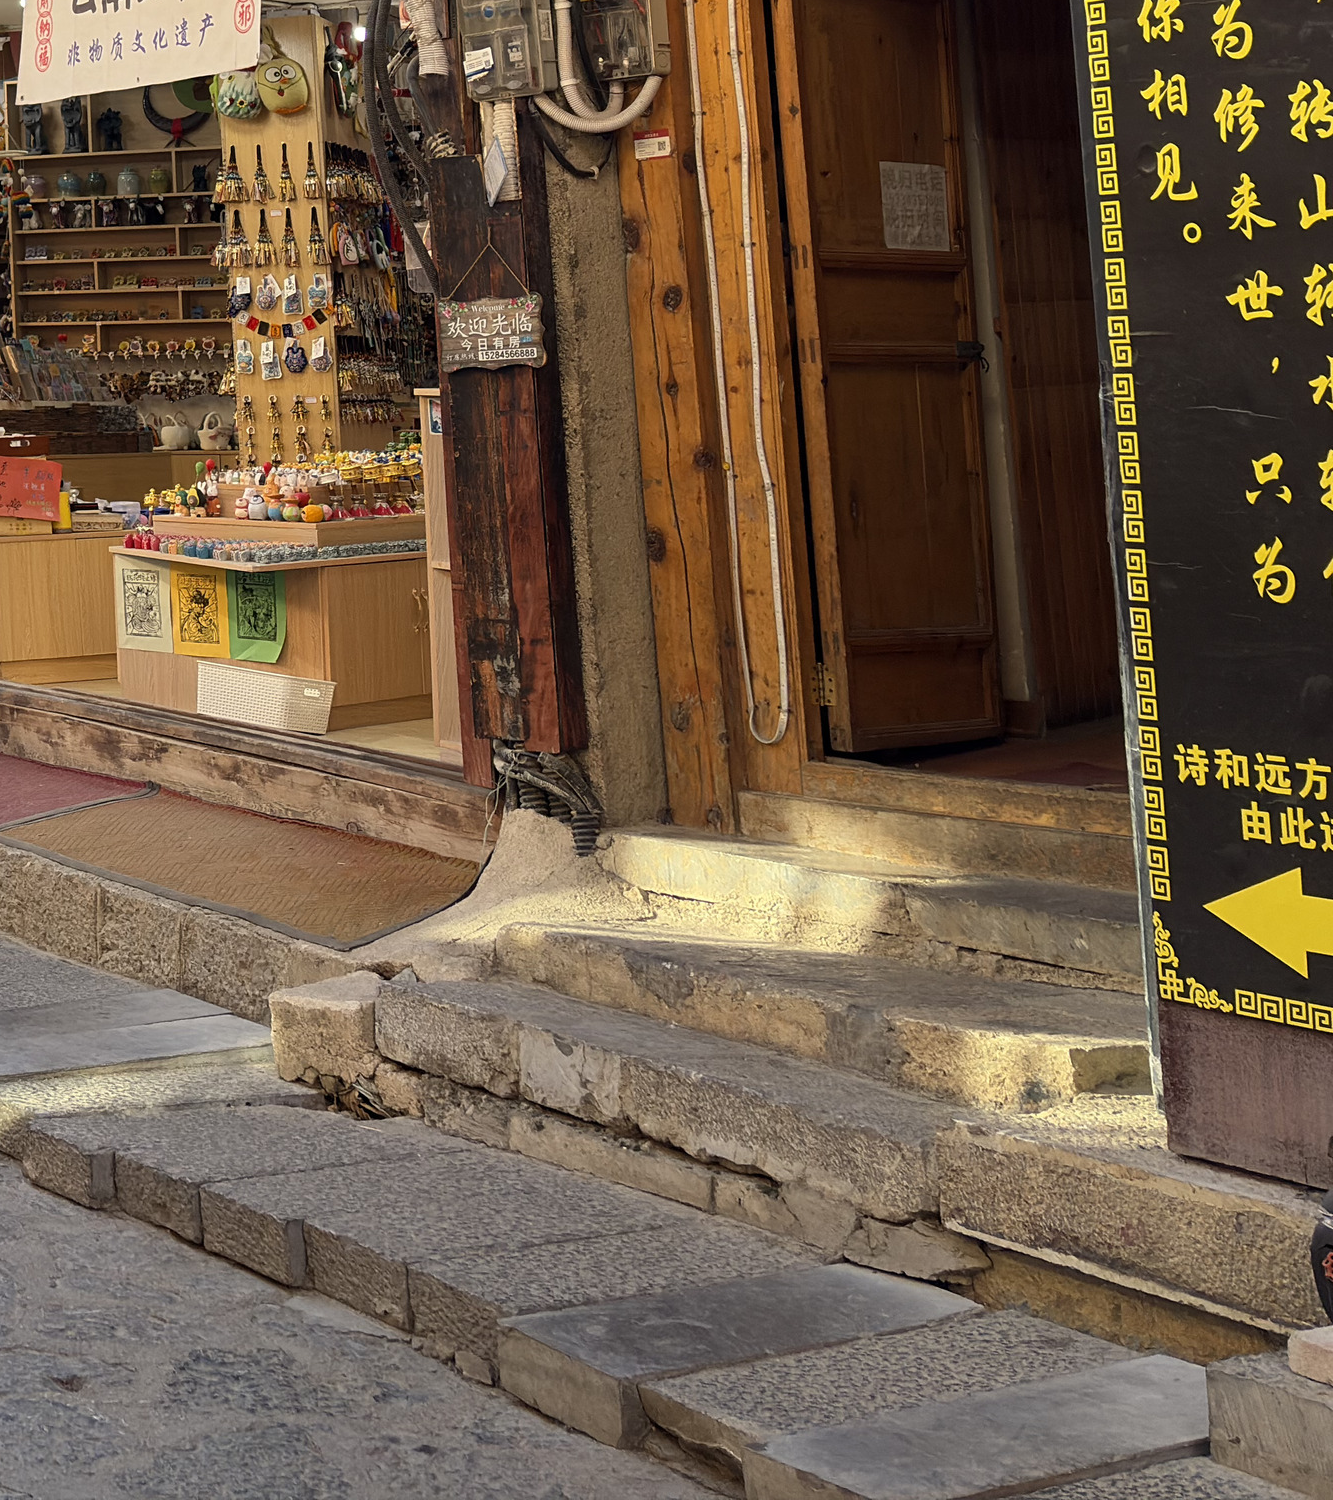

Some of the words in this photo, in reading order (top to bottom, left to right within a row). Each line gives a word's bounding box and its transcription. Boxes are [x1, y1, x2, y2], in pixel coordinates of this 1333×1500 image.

[471, 304, 505, 313] Welcome
[447, 313, 532, 338] 欢迎光临
[461, 336, 520, 351] 今日有房
[480, 348, 535, 359] 15284566888
[1174, 744, 1332, 800] 诗和远方
